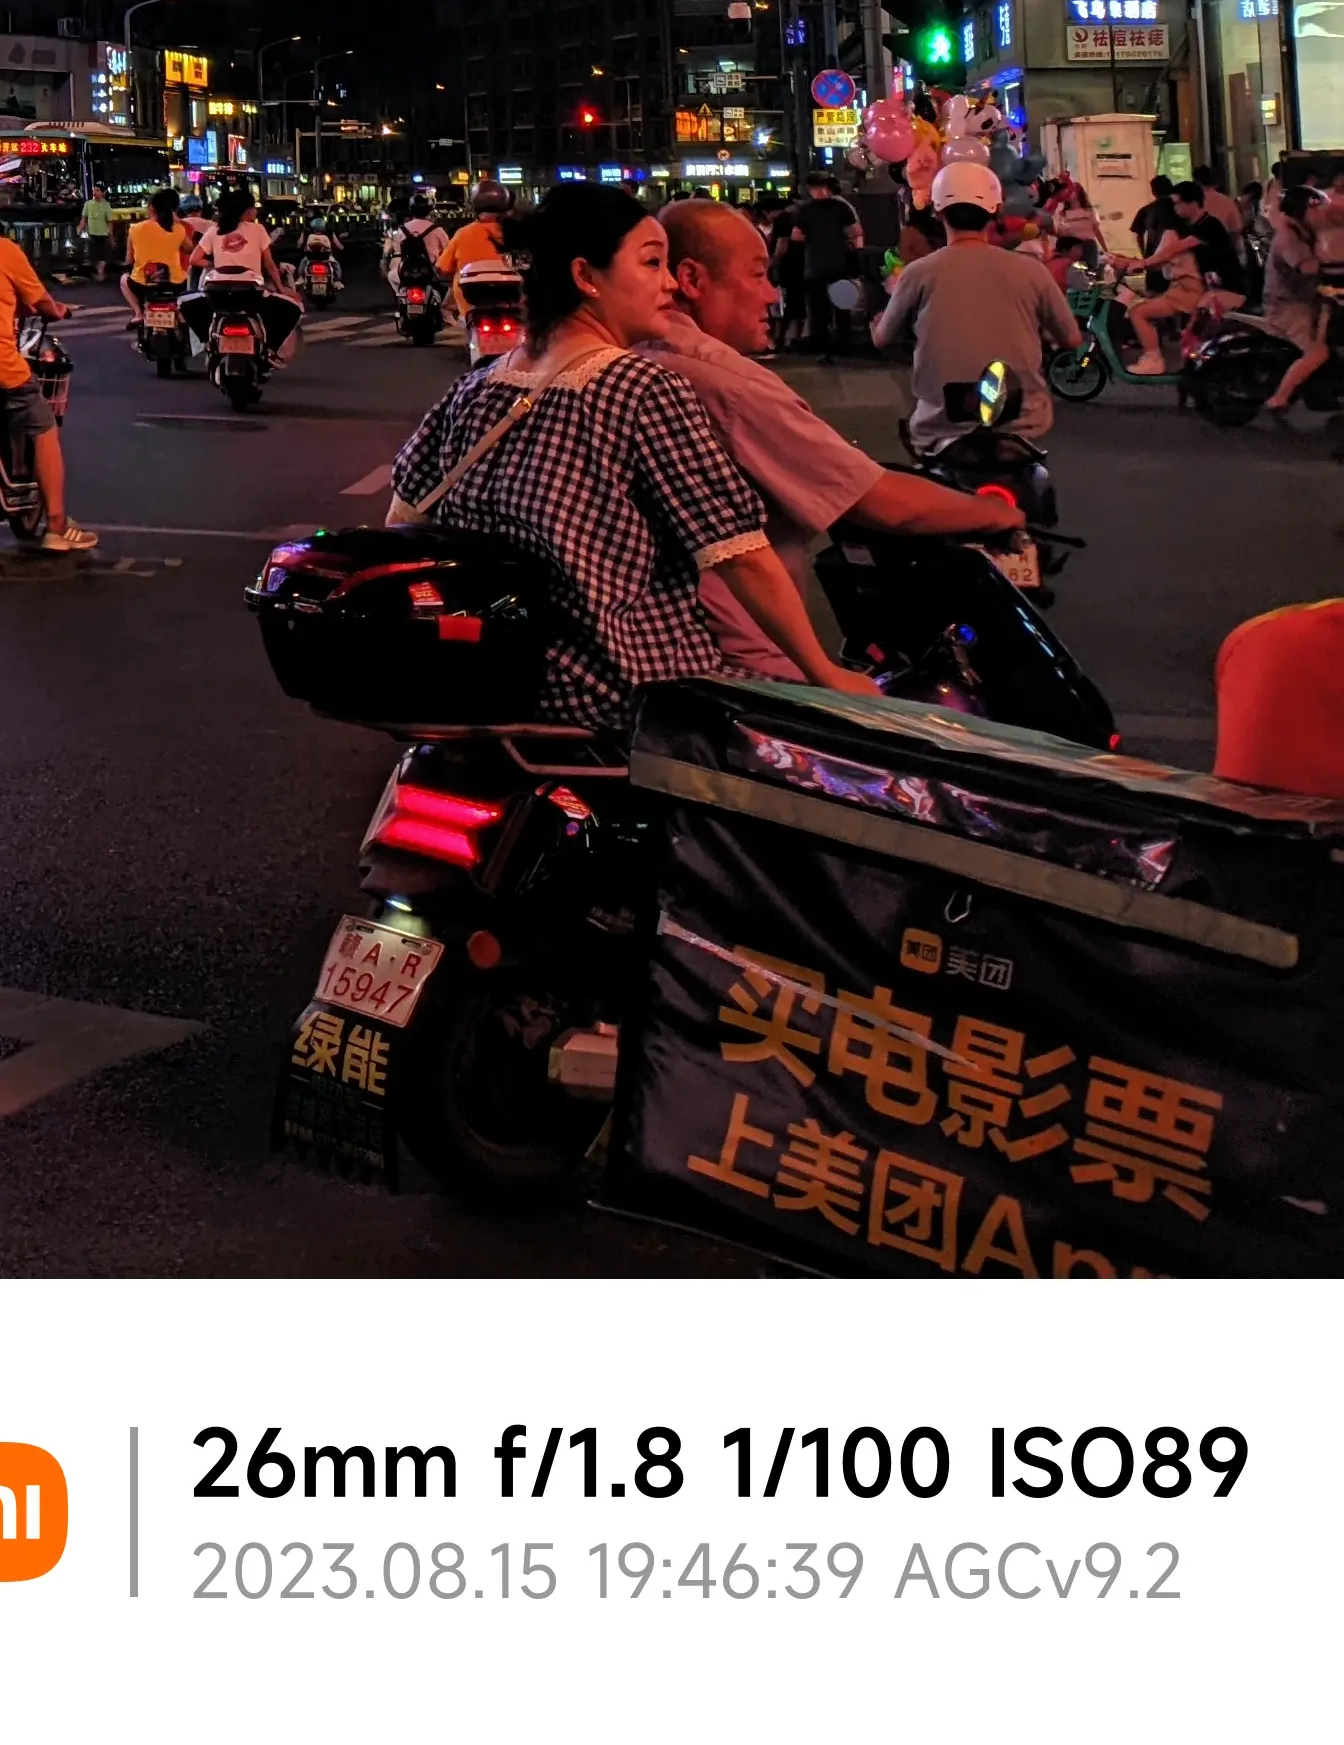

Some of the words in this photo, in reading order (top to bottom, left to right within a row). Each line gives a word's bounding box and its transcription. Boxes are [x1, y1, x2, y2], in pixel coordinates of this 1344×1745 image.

[20, 141, 40, 153] 232
[41, 141, 67, 153] 火车站
[321, 963, 415, 1015] 15947
[945, 946, 1013, 990] 美团
[290, 1010, 391, 1097] 绿能
[718, 944, 1224, 1221] 买电影票
[686, 1092, 1178, 1279] 上美团A
